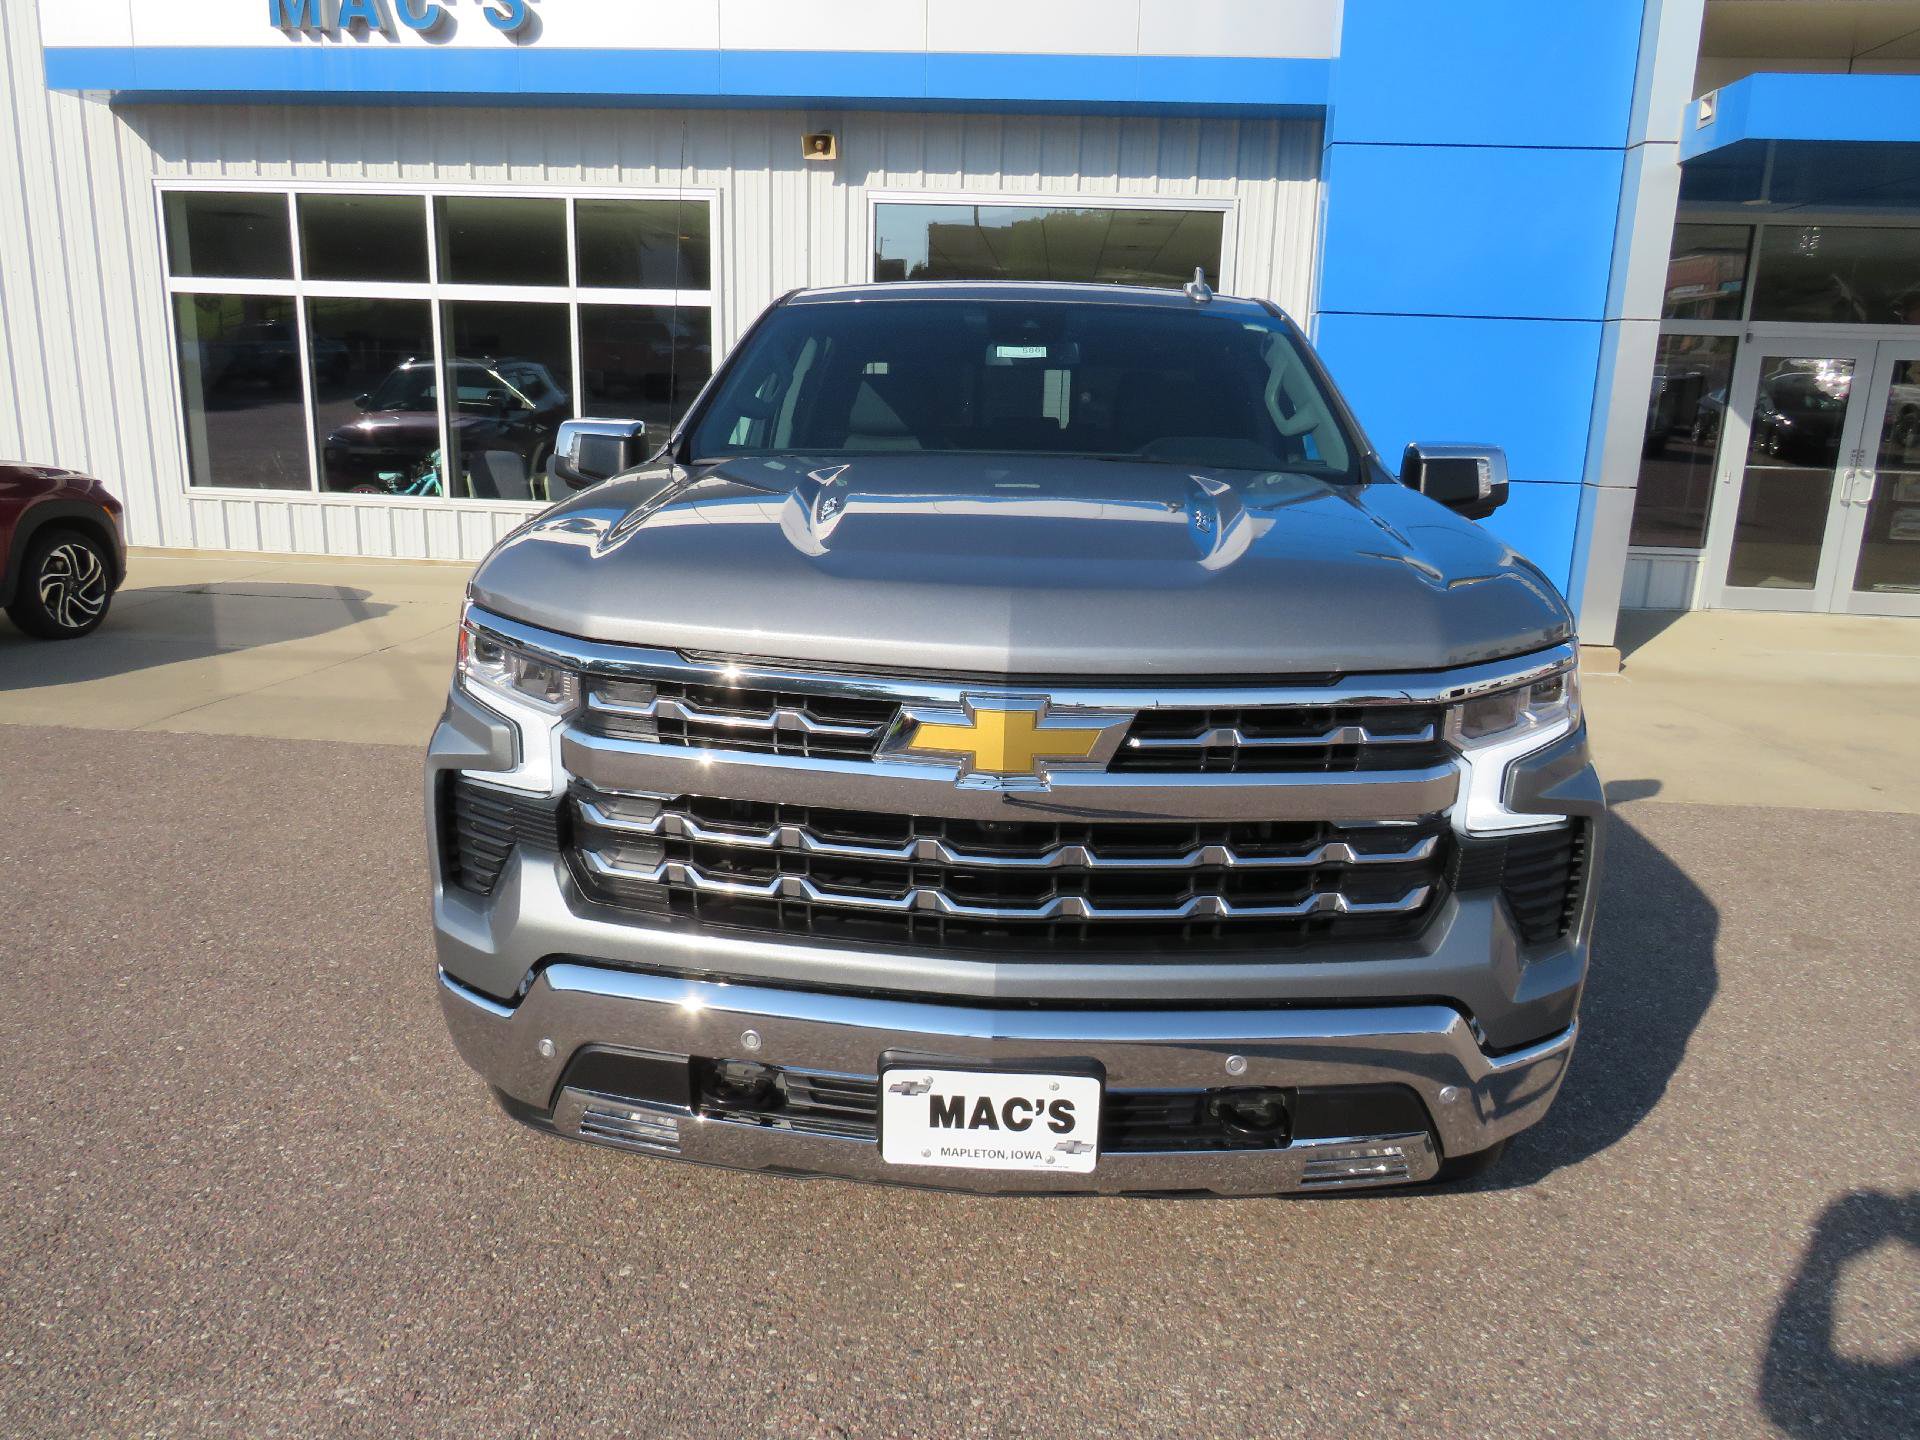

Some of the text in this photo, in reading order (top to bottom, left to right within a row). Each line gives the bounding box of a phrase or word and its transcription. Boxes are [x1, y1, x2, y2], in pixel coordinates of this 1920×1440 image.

[269, 0, 526, 30] MACS
[929, 1094, 1076, 1134] MAC'S
[940, 1147, 1043, 1160] MAPLETON, IOWA
